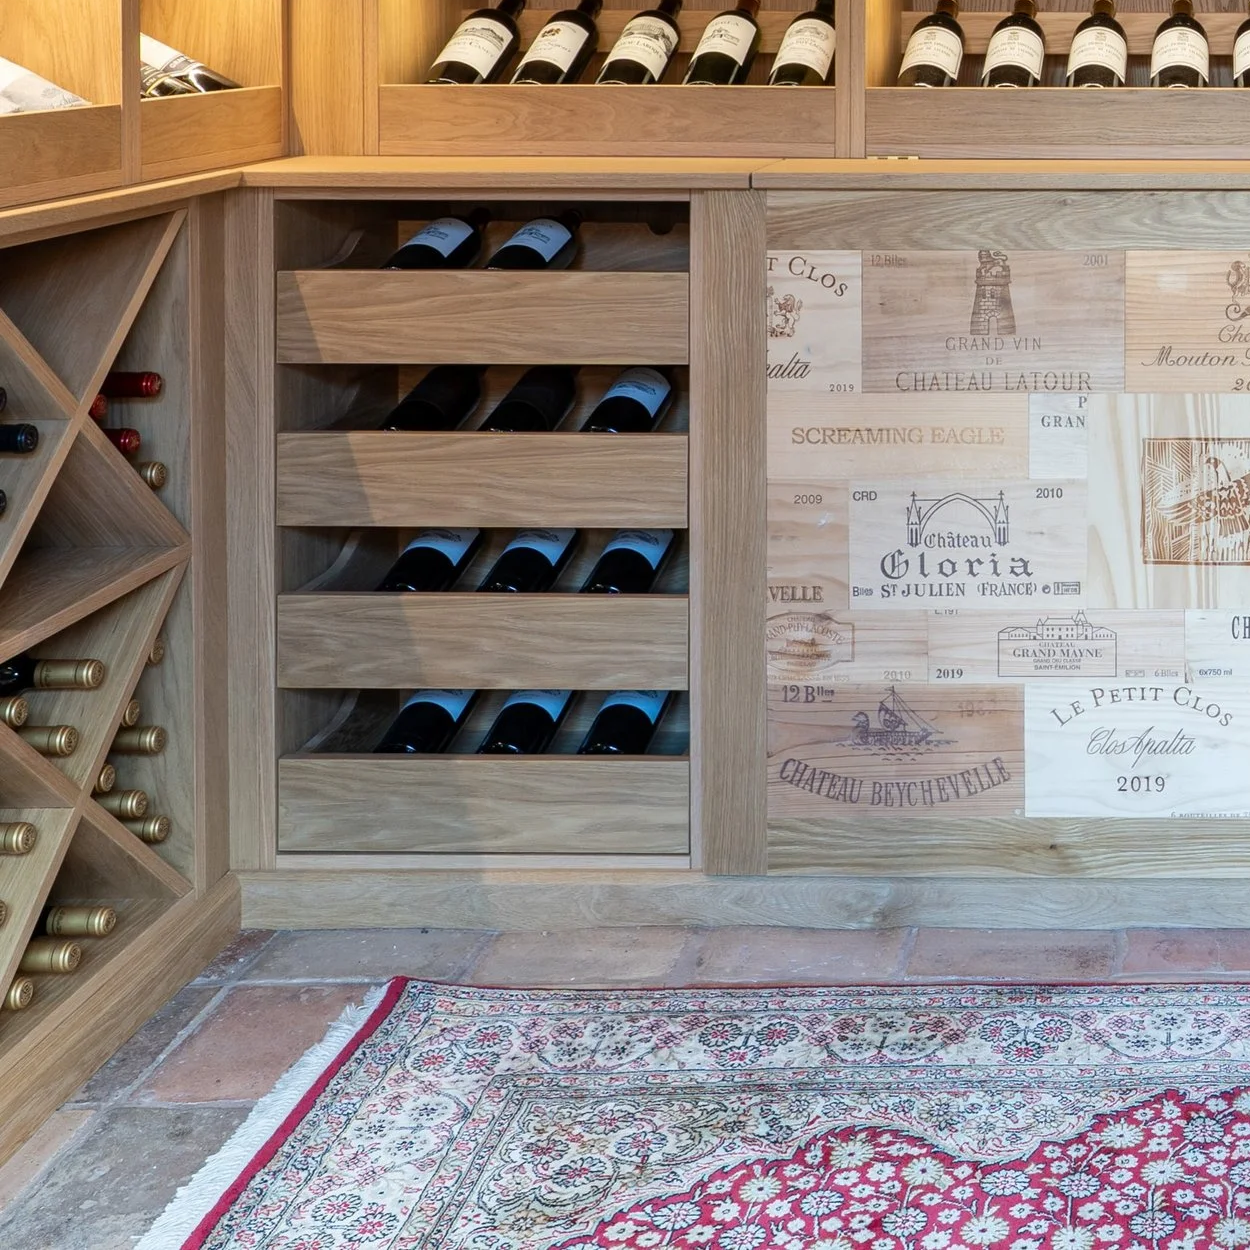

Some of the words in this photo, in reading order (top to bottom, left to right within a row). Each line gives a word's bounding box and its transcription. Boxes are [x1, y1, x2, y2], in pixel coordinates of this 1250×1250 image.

[1083, 254, 1108, 266] 2001
[788, 256, 848, 297] CLOS
[945, 336, 1005, 351] GRAND
[1012, 336, 1042, 351] VIN
[985, 356, 1002, 366] DE
[1141, 346, 1237, 367] Mouton
[829, 384, 854, 392] 2019
[895, 371, 992, 392] CHATEAU
[1004, 371, 1092, 392] LATOUR
[1041, 415, 1086, 428] GRAN
[791, 427, 923, 444] SCREAMING
[930, 427, 1005, 444] EAGLE
[793, 494, 823, 505] 2009
[852, 491, 878, 501] CRD
[1036, 487, 1063, 499] 2010
[923, 531, 993, 549] Château
[880, 548, 1034, 580] Gloria
[767, 585, 824, 603] VELLE
[901, 582, 966, 598] JULIEN
[976, 581, 1037, 597] (FRANCE)
[1012, 648, 1056, 658] GRAND
[1060, 648, 1103, 658] MAYNE
[936, 668, 963, 679] 2019
[782, 685, 800, 703] 12
[1052, 700, 1085, 727] LE
[1089, 687, 1164, 708] PETIT
[1173, 686, 1234, 727] CLOS
[779, 758, 863, 804] CHATEAU
[871, 757, 1011, 807] BEYCHEVELLE
[1117, 776, 1165, 792] 2019
